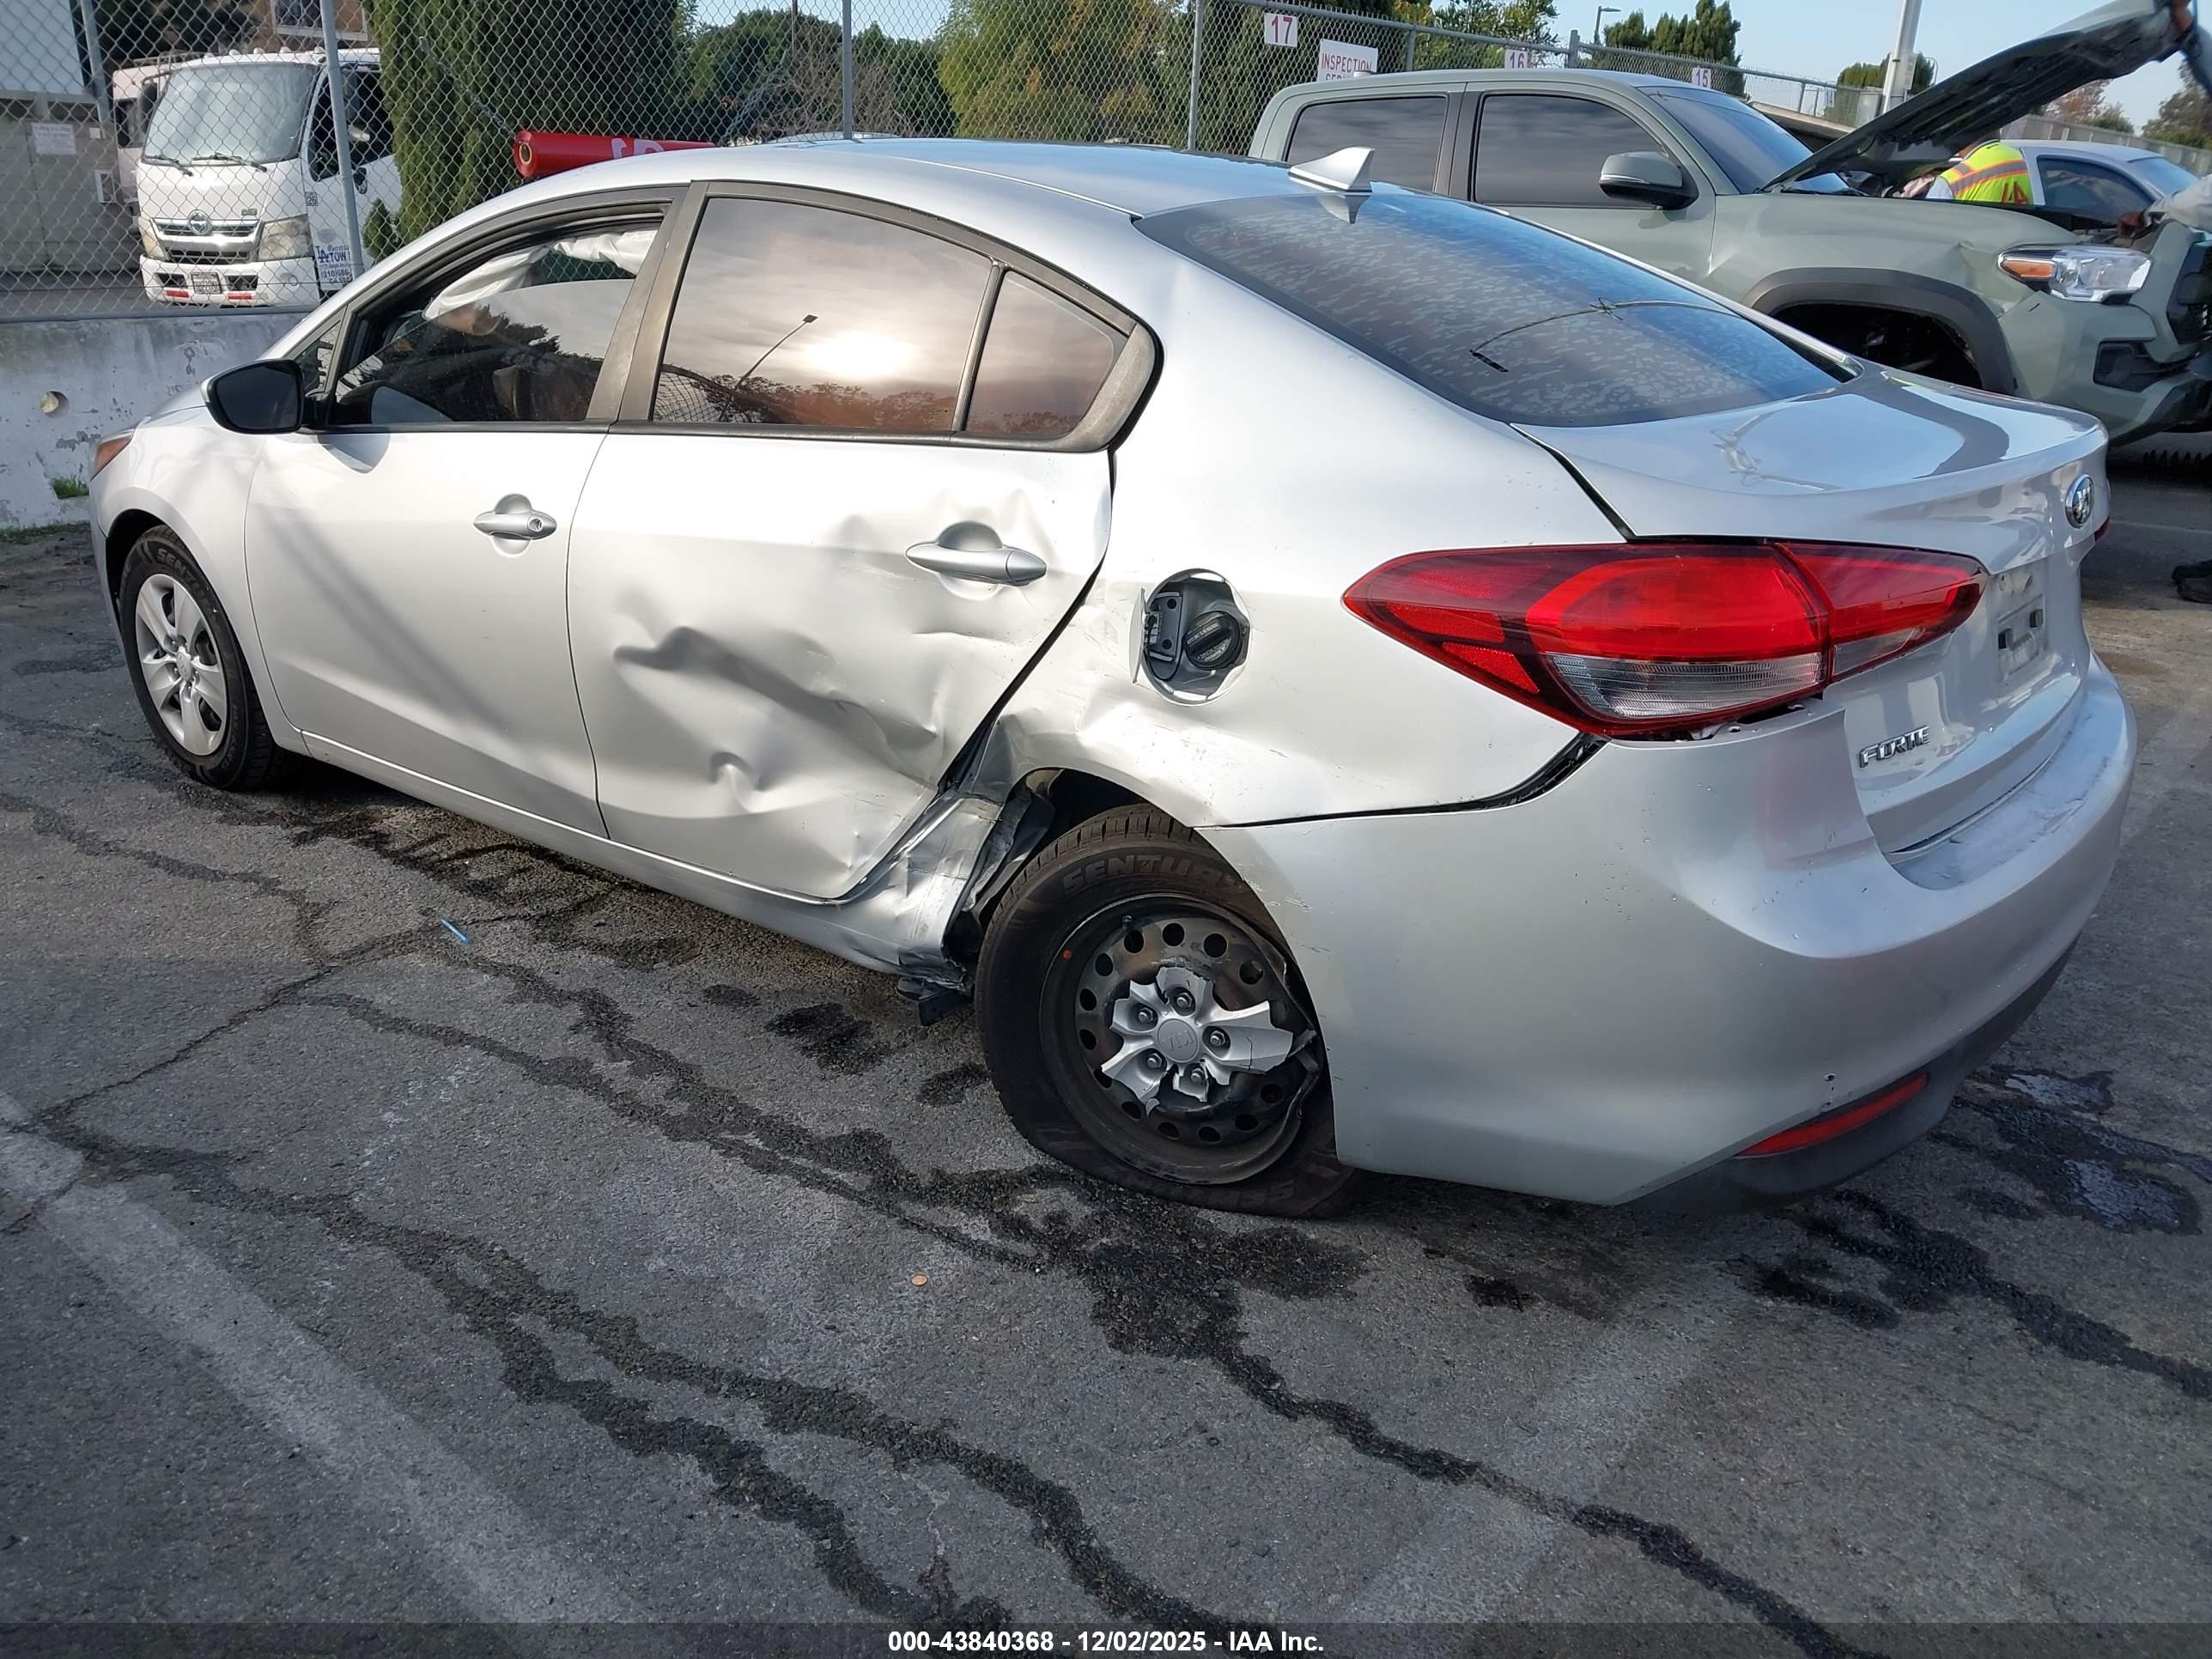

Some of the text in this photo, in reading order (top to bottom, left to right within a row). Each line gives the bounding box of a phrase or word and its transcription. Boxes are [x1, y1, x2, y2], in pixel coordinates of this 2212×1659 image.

[1272, 15, 1292, 44] 17
[1322, 54, 1372, 72] INSPECTION
[1510, 52, 1525, 68] 16
[1696, 69, 1709, 88] 15
[1859, 725, 1930, 768] FORTE
